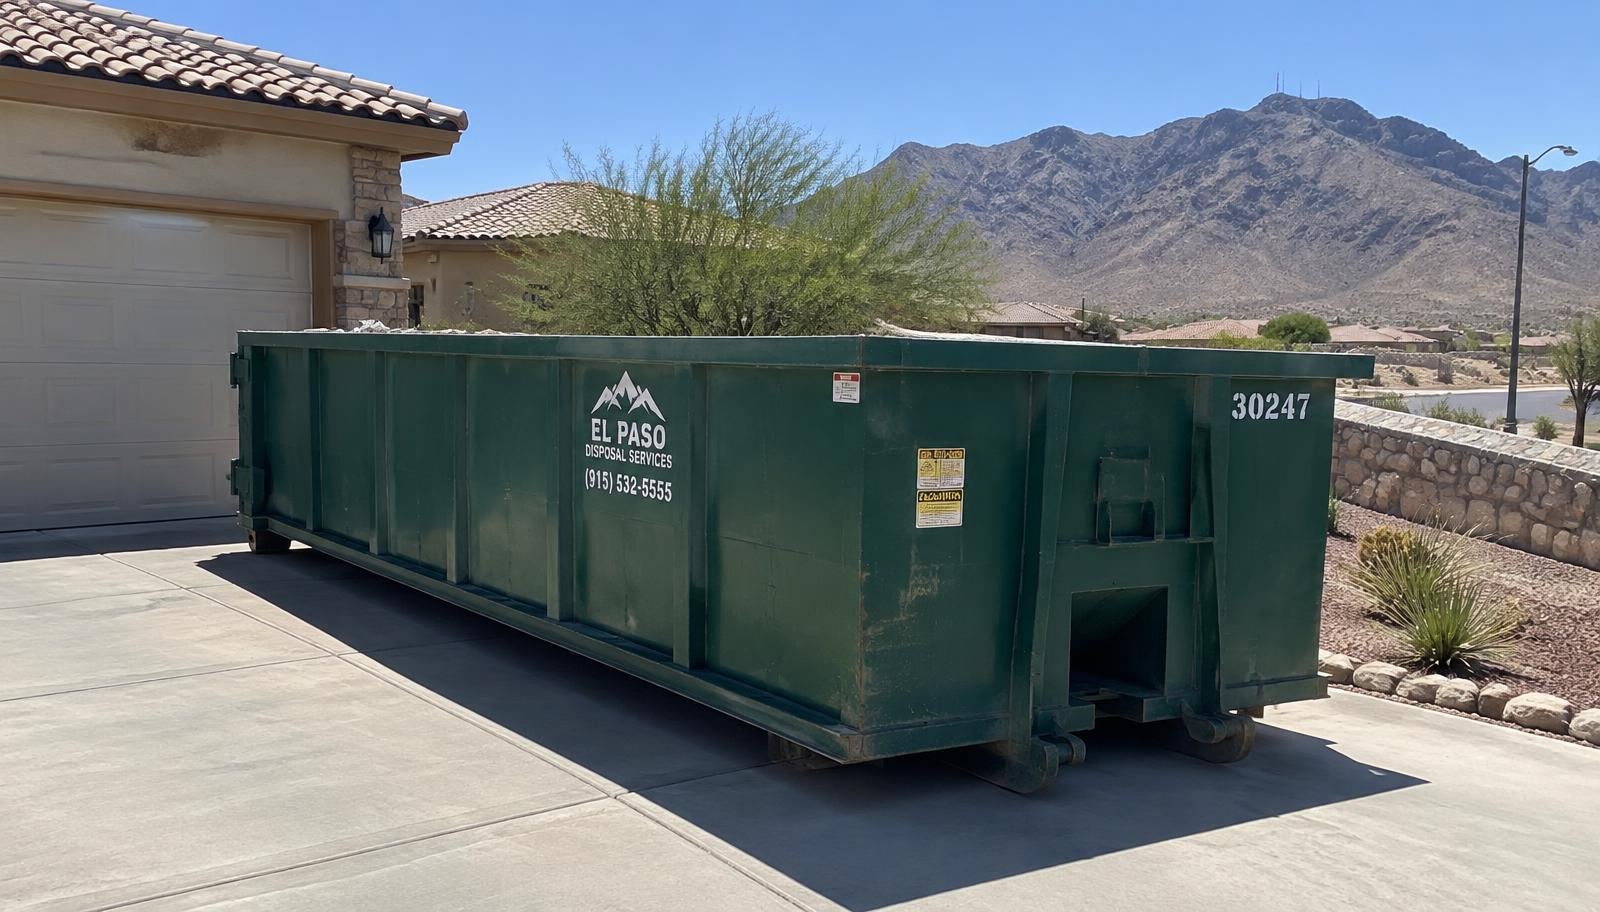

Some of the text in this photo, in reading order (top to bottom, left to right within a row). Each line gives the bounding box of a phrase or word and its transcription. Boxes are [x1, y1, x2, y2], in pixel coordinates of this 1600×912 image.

[1231, 392, 1311, 420] 30247
[591, 417, 666, 450] EL PASO
[585, 443, 673, 469] DISPOSAL SERVICES
[585, 467, 673, 503] (915) 532-5555
